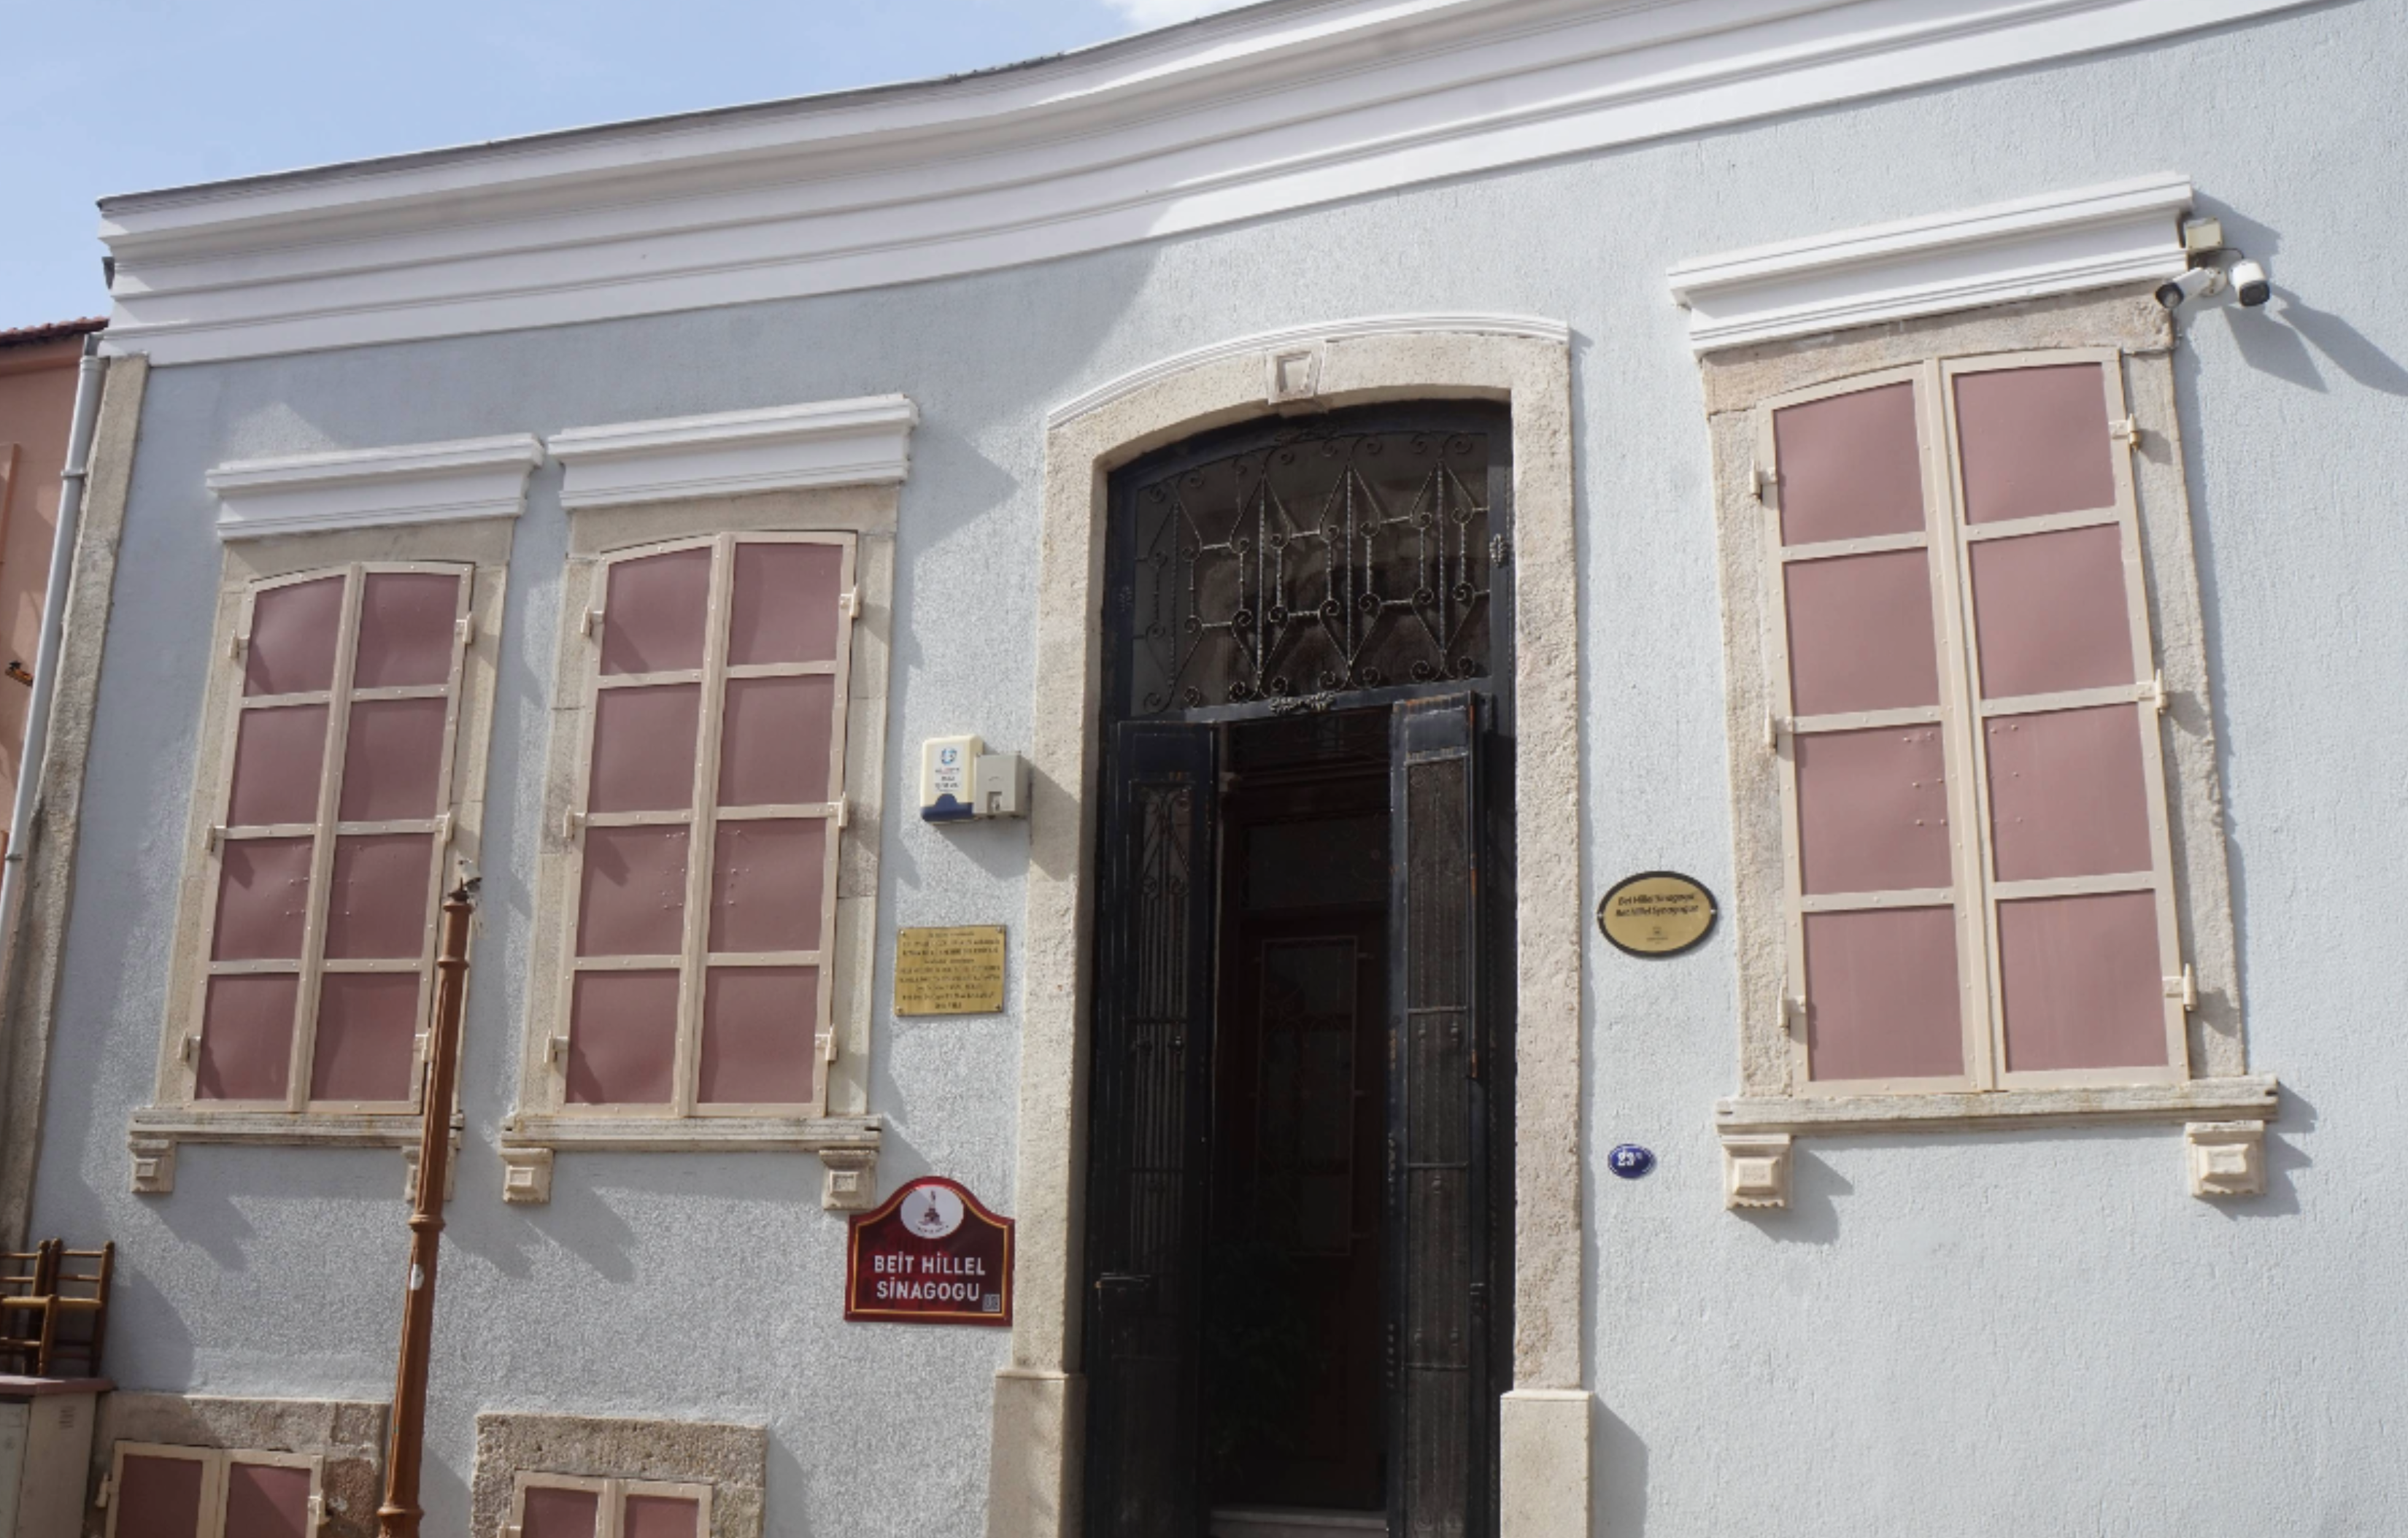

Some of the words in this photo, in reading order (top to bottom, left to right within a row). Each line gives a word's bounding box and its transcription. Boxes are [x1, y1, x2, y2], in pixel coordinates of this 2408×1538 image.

[874, 1251, 914, 1274] BEİT
[922, 1251, 986, 1275] HİLLEL
[876, 1277, 979, 1301] SİNAGOGU
